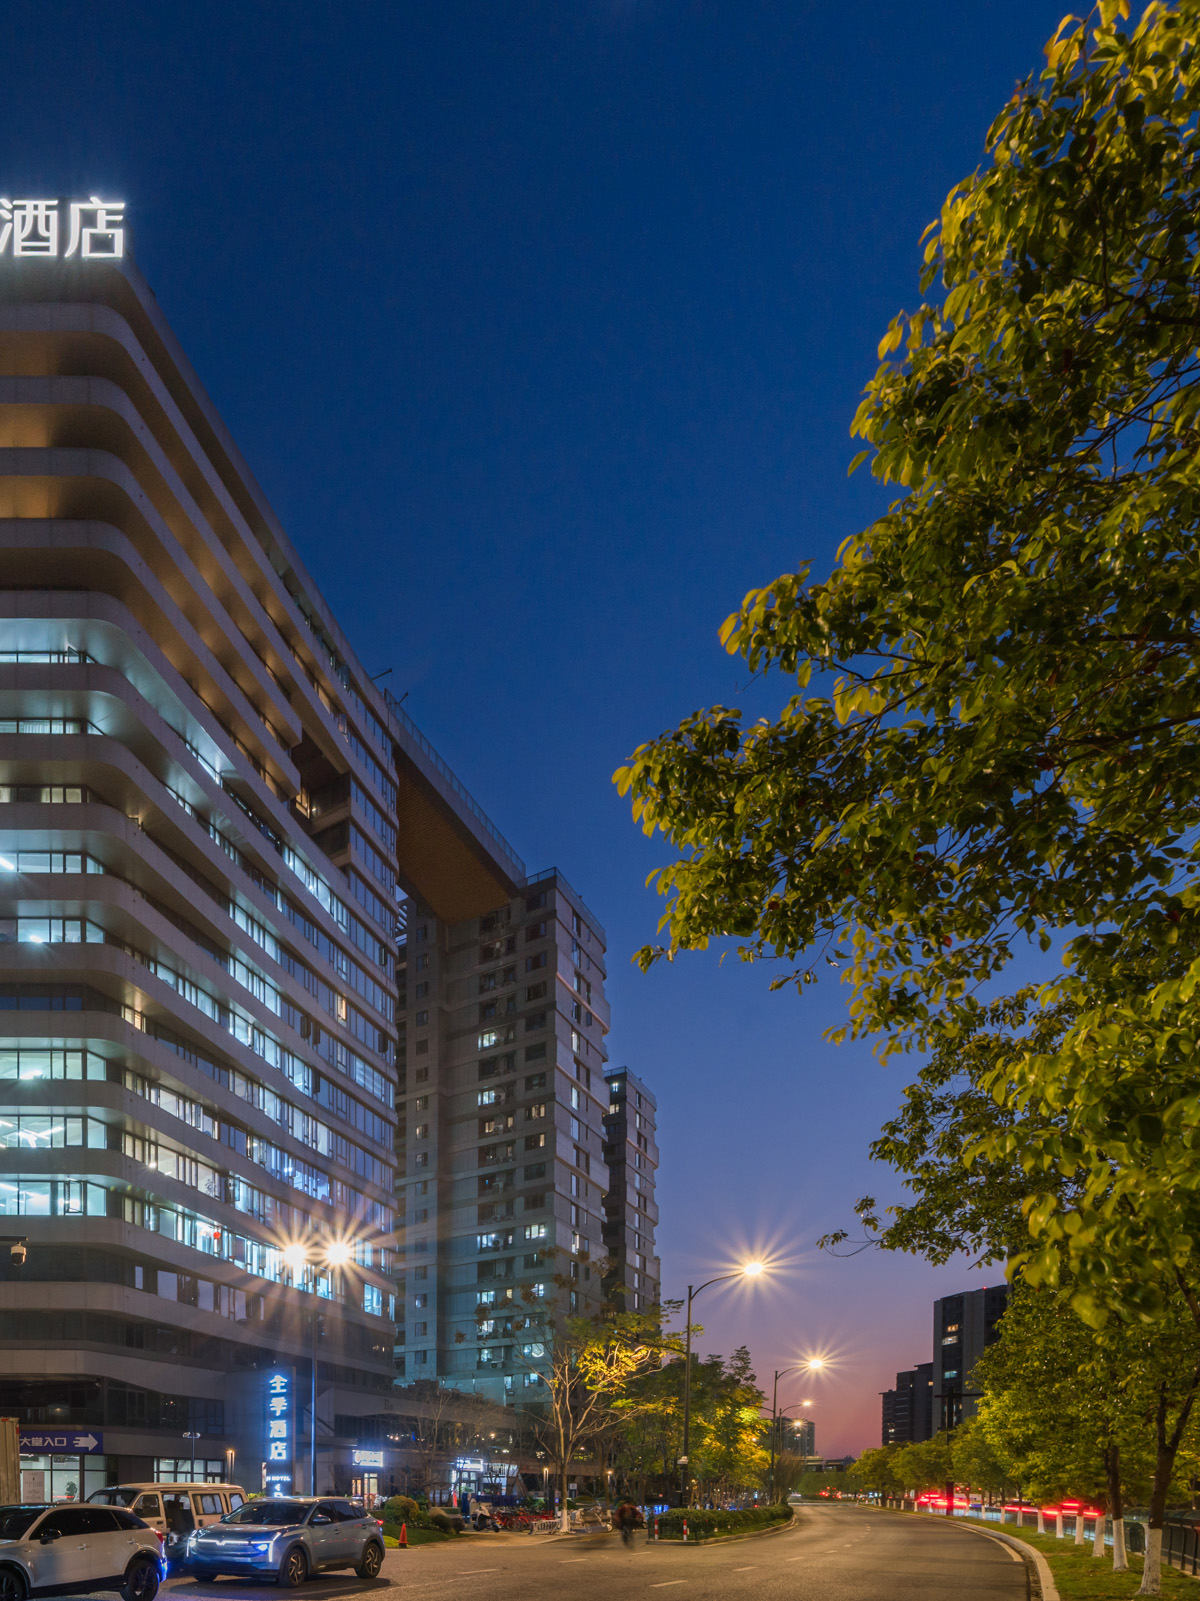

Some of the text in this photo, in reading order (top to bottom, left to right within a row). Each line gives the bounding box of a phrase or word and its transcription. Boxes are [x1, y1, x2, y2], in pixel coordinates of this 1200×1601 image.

[269, 1374, 288, 1460] 全季酒店
[19, 1437, 67, 1447] 大堂入口
